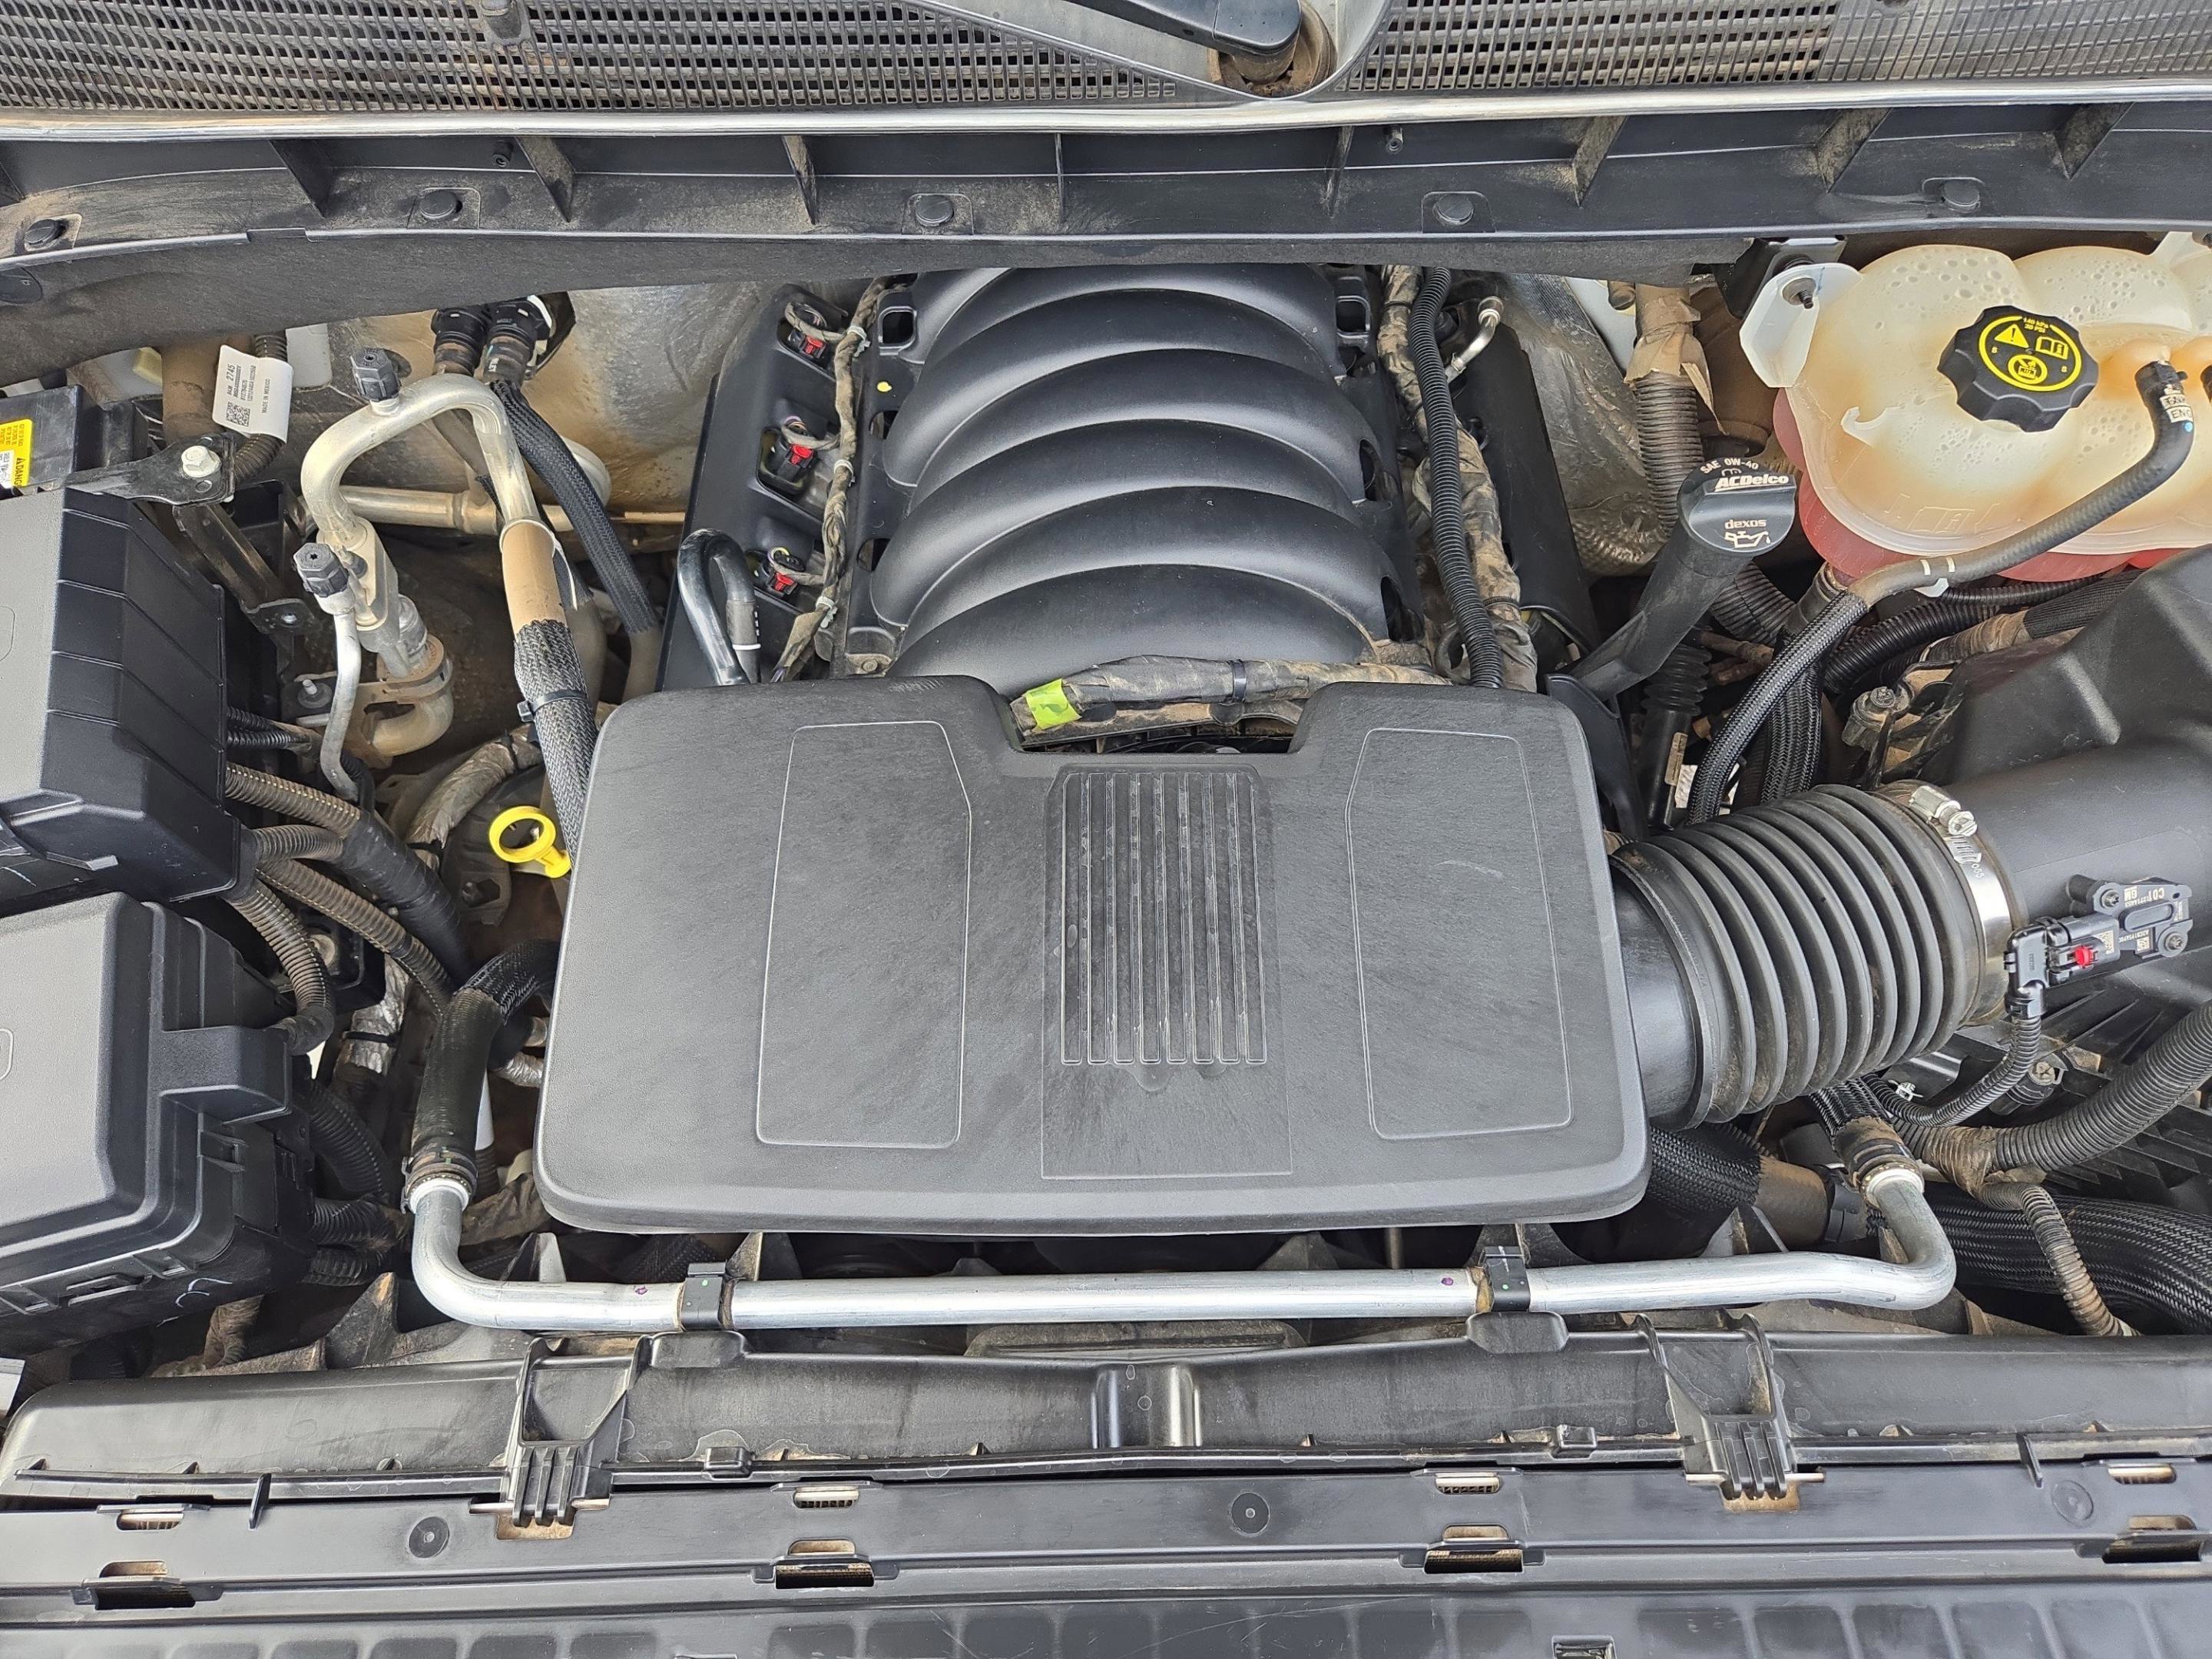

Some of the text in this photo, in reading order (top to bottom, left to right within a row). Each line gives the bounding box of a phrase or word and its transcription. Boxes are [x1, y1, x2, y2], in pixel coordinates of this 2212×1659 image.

[226, 363, 236, 381] 2745
[1700, 458, 1760, 474] SAE 0W-40
[14, 465, 25, 488] DANG
[1714, 474, 1790, 492] ACDelco
[1724, 519, 1767, 529] dexos
[2124, 886, 2137, 901] GM
